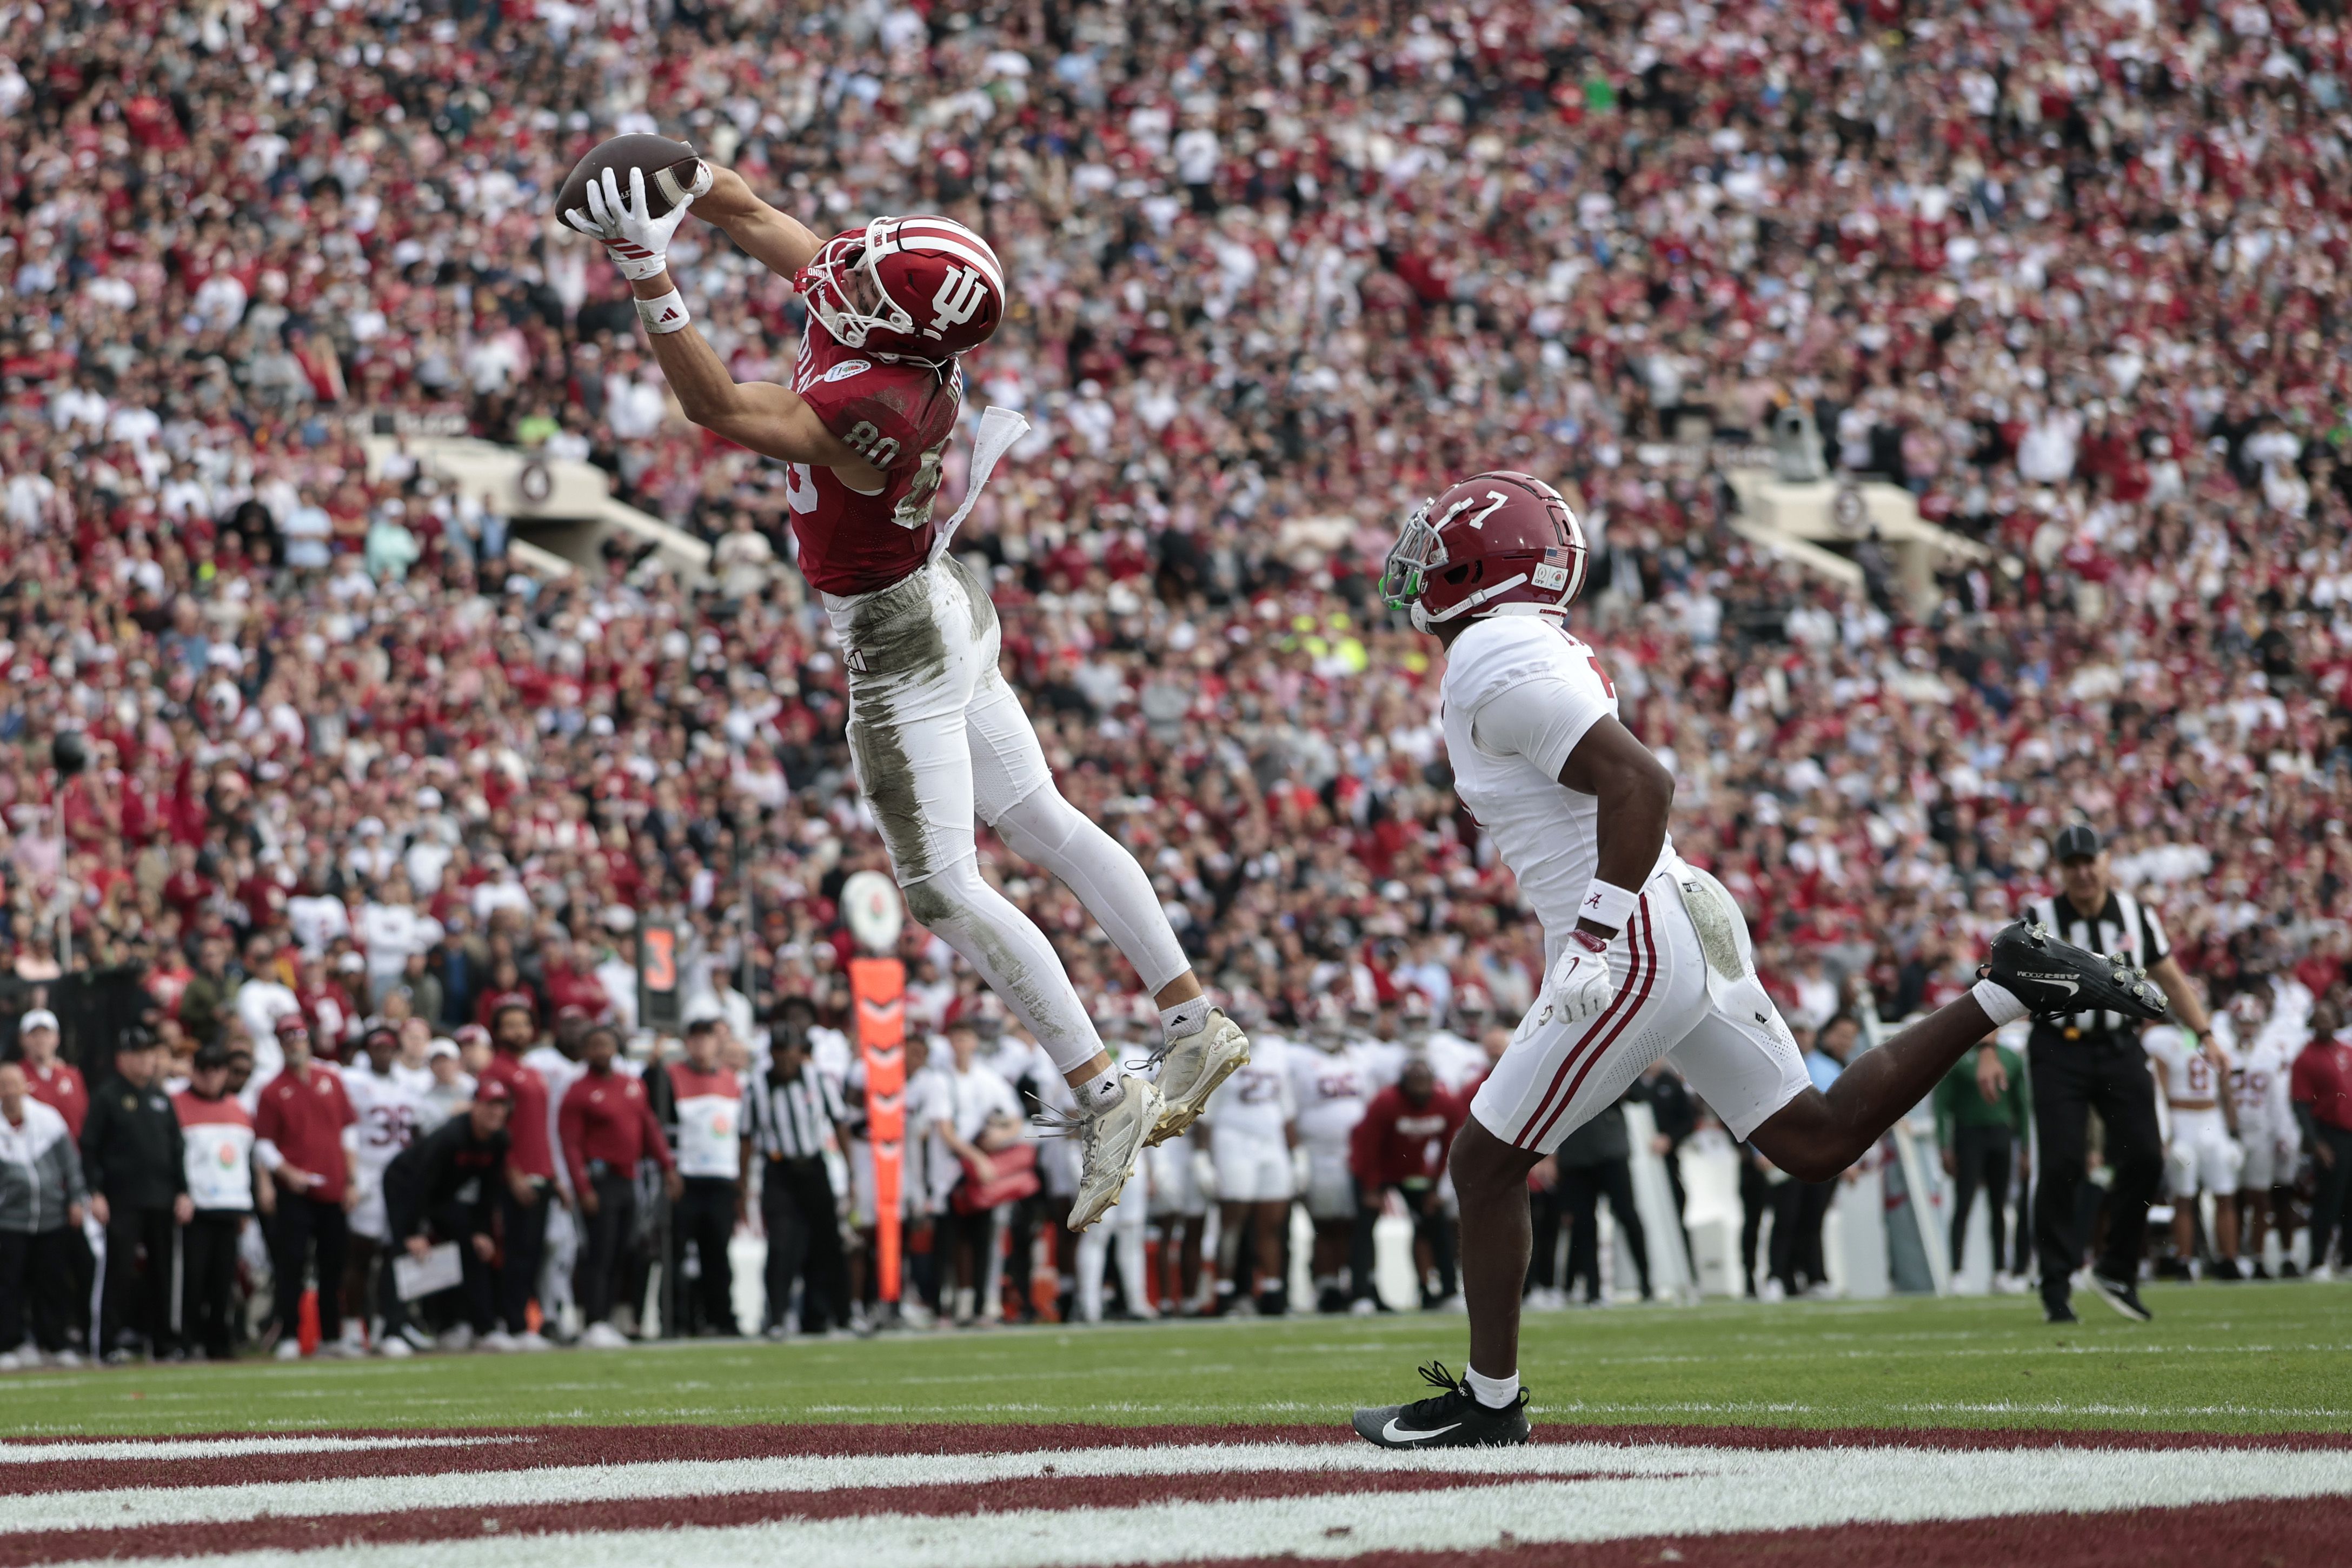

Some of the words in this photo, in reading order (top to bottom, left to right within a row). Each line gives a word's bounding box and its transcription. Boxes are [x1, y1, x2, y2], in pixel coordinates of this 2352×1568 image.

[841, 421, 900, 472] 80
[1469, 490, 1509, 530] 7
[643, 927, 677, 992] 3
[2017, 971, 2044, 979] ZOOM
